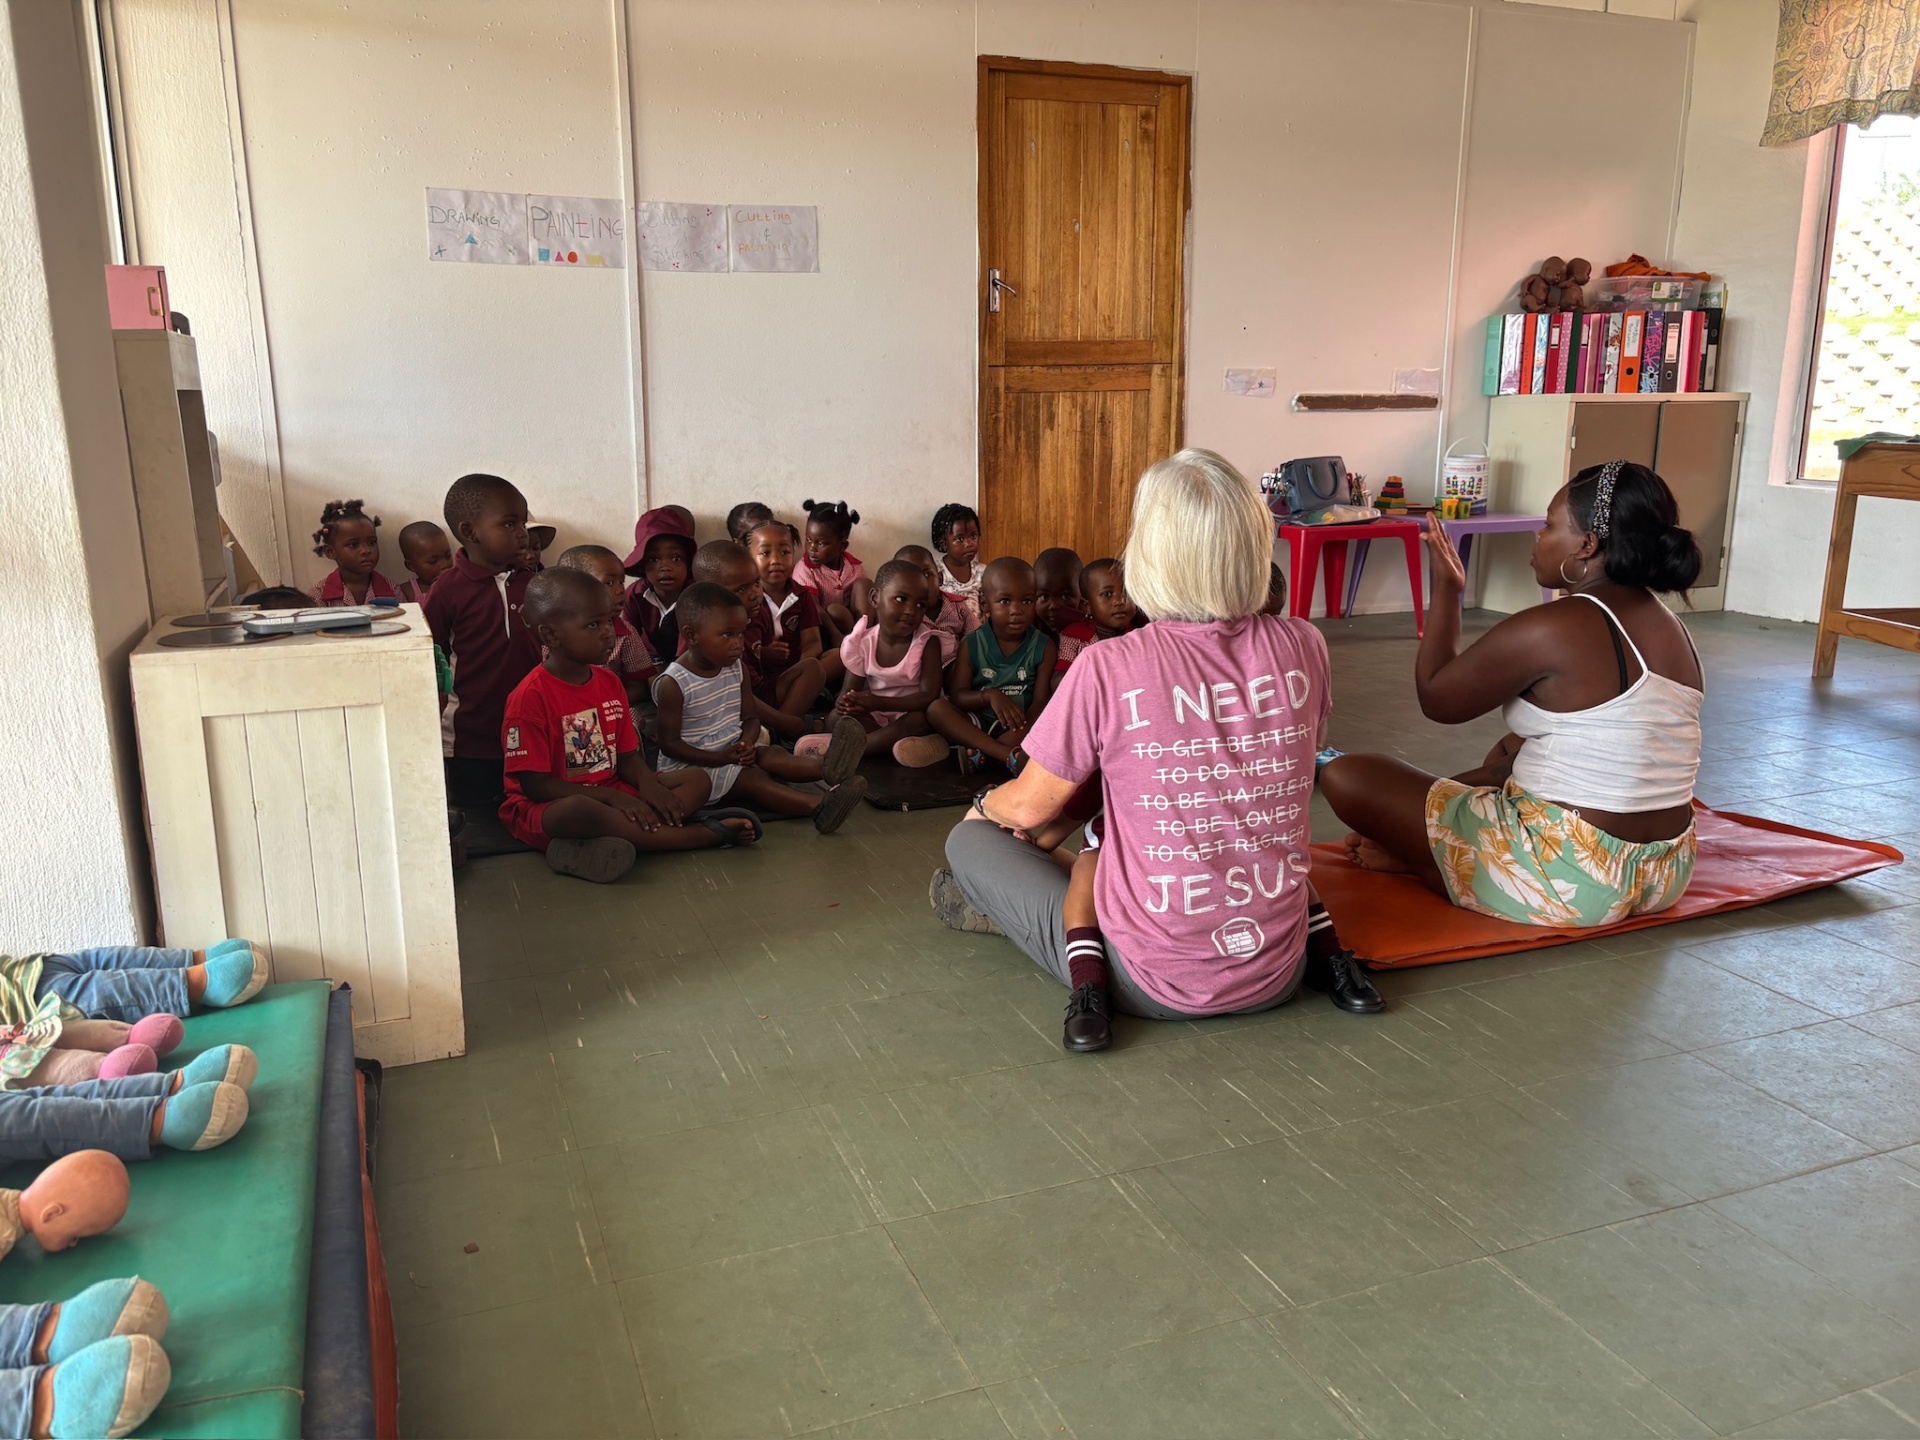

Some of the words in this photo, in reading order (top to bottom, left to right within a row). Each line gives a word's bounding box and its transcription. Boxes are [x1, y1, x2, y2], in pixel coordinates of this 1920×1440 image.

[1119, 688, 1151, 731] I
[1172, 670, 1311, 725] NEED
[1133, 742, 1163, 759] TO
[1172, 737, 1220, 758] GET
[1227, 723, 1310, 753] BETTER
[1155, 767, 1188, 785] TO
[1198, 763, 1230, 782] DO
[1236, 755, 1299, 778] WELL
[1138, 794, 1169, 811] TO
[1178, 791, 1210, 810] BE
[1217, 775, 1310, 806] HAPPIER
[1155, 820, 1186, 837] TO
[1195, 815, 1225, 834] BE
[1234, 803, 1301, 831] LOVED
[1144, 844, 1173, 862] TO
[1183, 839, 1228, 863] GET
[1235, 825, 1305, 853] RICHER
[1144, 852, 1309, 915] JESUS
